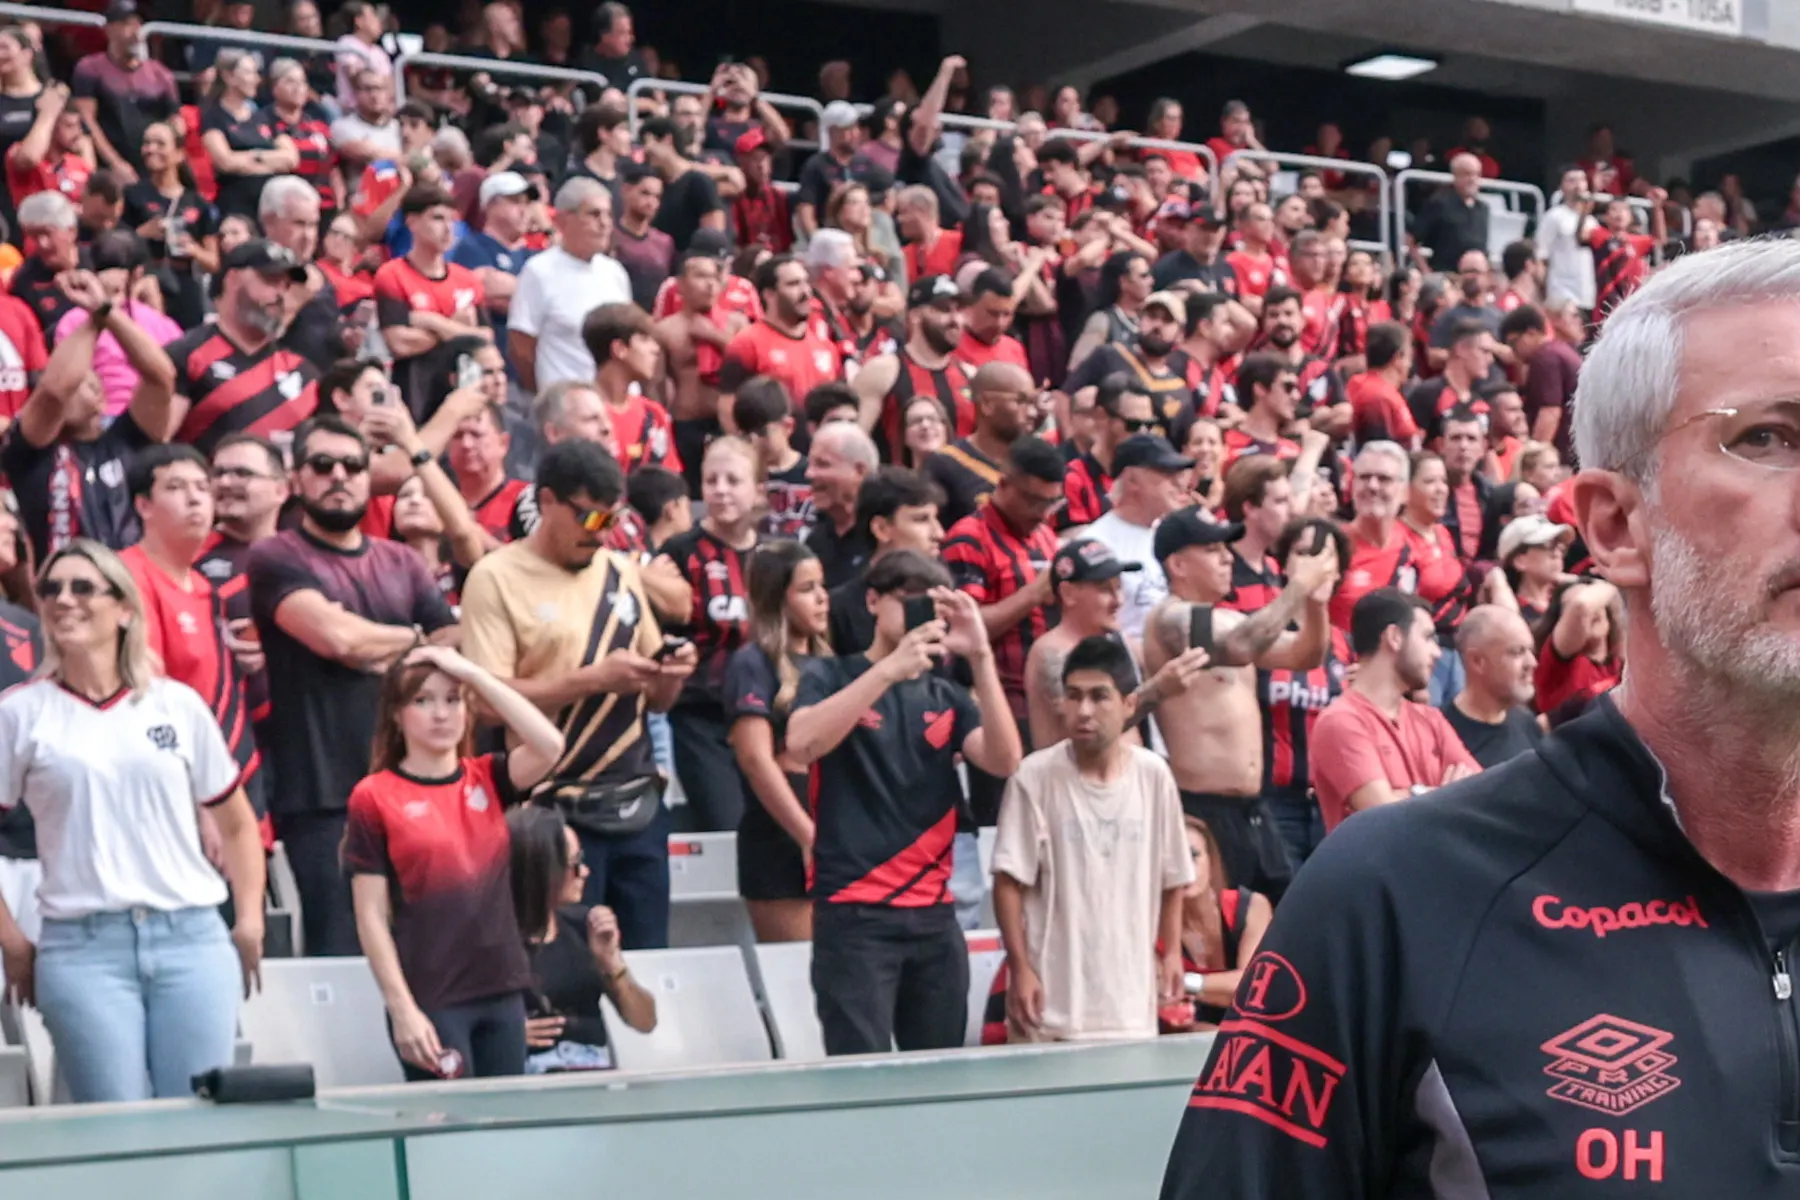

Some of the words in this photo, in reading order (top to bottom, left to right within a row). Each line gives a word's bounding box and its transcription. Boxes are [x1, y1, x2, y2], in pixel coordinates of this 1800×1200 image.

[1268, 680, 1330, 707] Phil
[1532, 894, 1709, 938] Copacol
[1194, 1036, 1340, 1129] AVAN
[1556, 1050, 1664, 1085] PRO
[1566, 1074, 1670, 1110] TRAINING
[1575, 1127, 1663, 1182] OH
